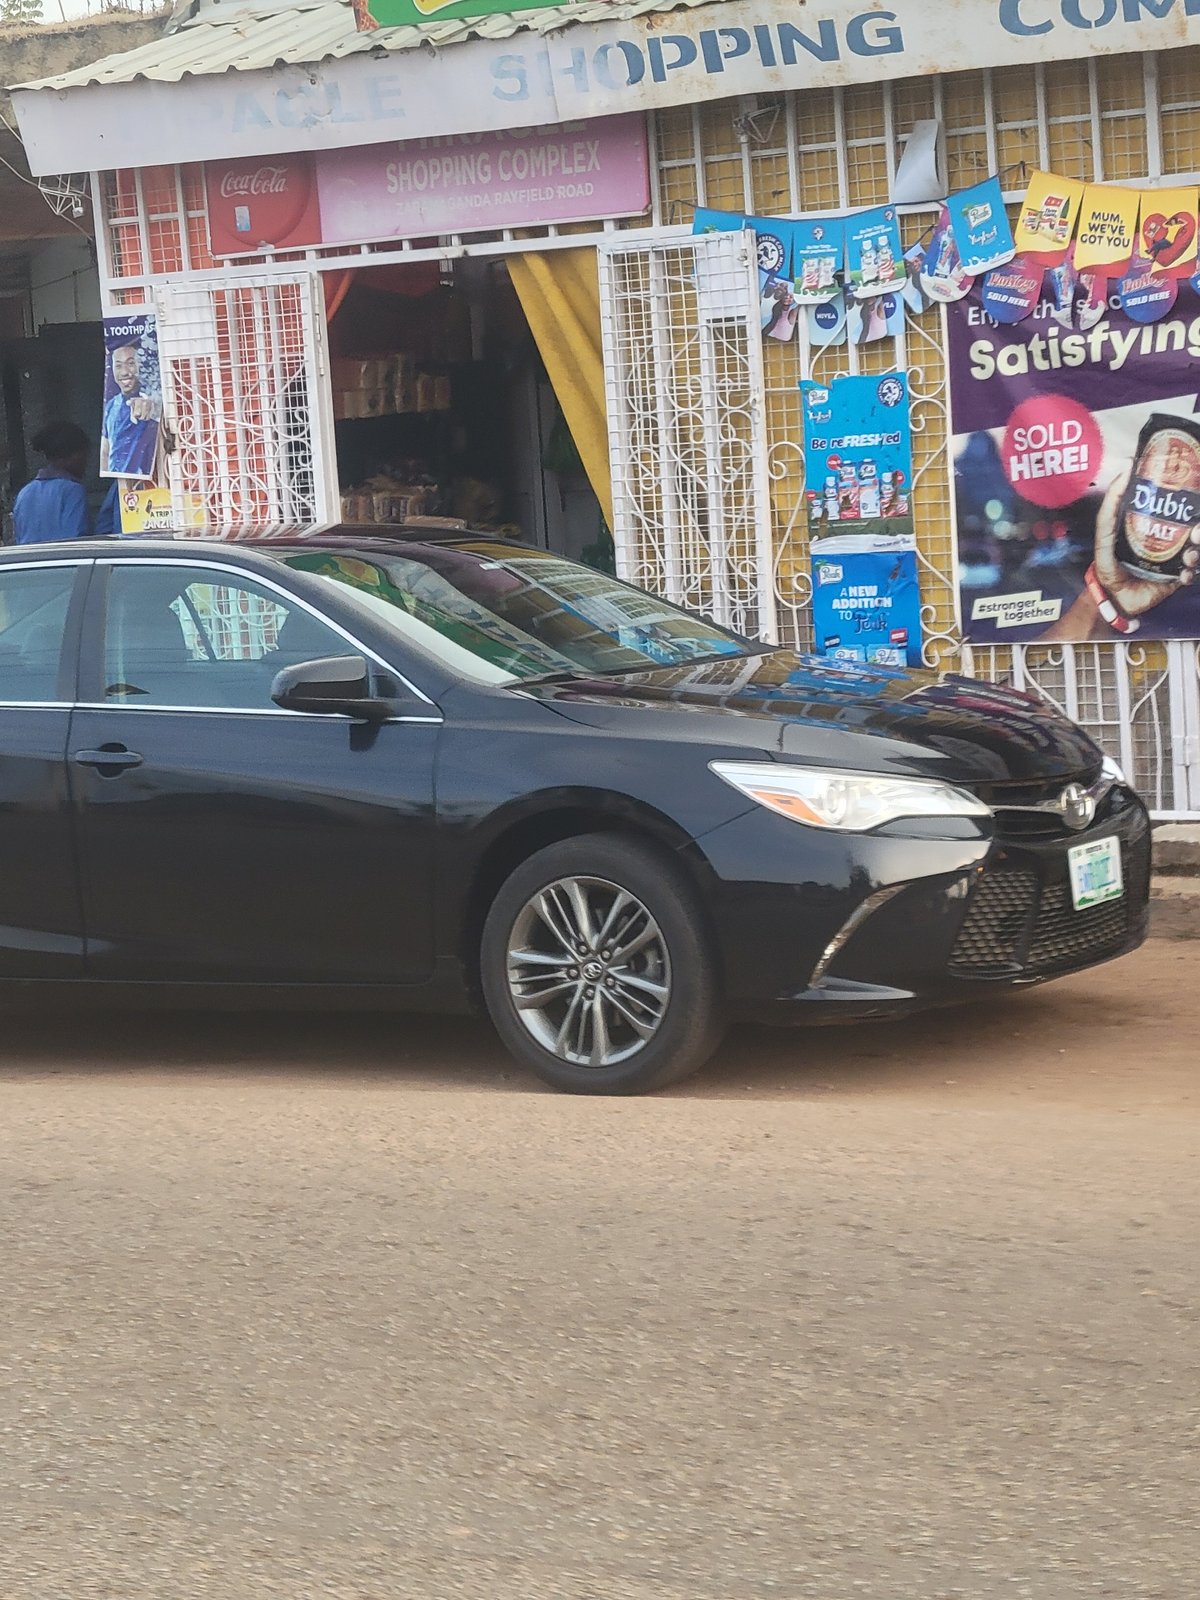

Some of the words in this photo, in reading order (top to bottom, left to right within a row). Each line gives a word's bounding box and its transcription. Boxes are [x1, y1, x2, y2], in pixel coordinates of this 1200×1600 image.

[489, 11, 905, 103] SHOPPING
[386, 152, 492, 194] SHOPPING
[498, 140, 601, 182] COMPLEX
[494, 187, 554, 207] RAYFIELD
[557, 182, 594, 200] ROAD
[1091, 211, 1124, 224] MUM,
[1088, 222, 1126, 236] WE'VE
[1080, 233, 1103, 245] GOT
[1106, 236, 1131, 248] YOU
[986, 291, 1009, 303] SOLD
[1007, 296, 1032, 308] HERE
[1126, 295, 1149, 308] SOLD
[1148, 290, 1172, 303] HERE
[816, 312, 837, 320] NIVEA
[811, 437, 827, 450] Be
[1013, 420, 1082, 452] SOLD
[1009, 444, 1089, 482] HERE!
[1131, 483, 1195, 522] Dubic
[839, 587, 848, 597] A
[848, 585, 878, 597] NEW
[831, 597, 893, 610] ADDITION
[978, 598, 1037, 617] #stronger
[838, 610, 853, 620] TO
[1004, 607, 1057, 623] together
